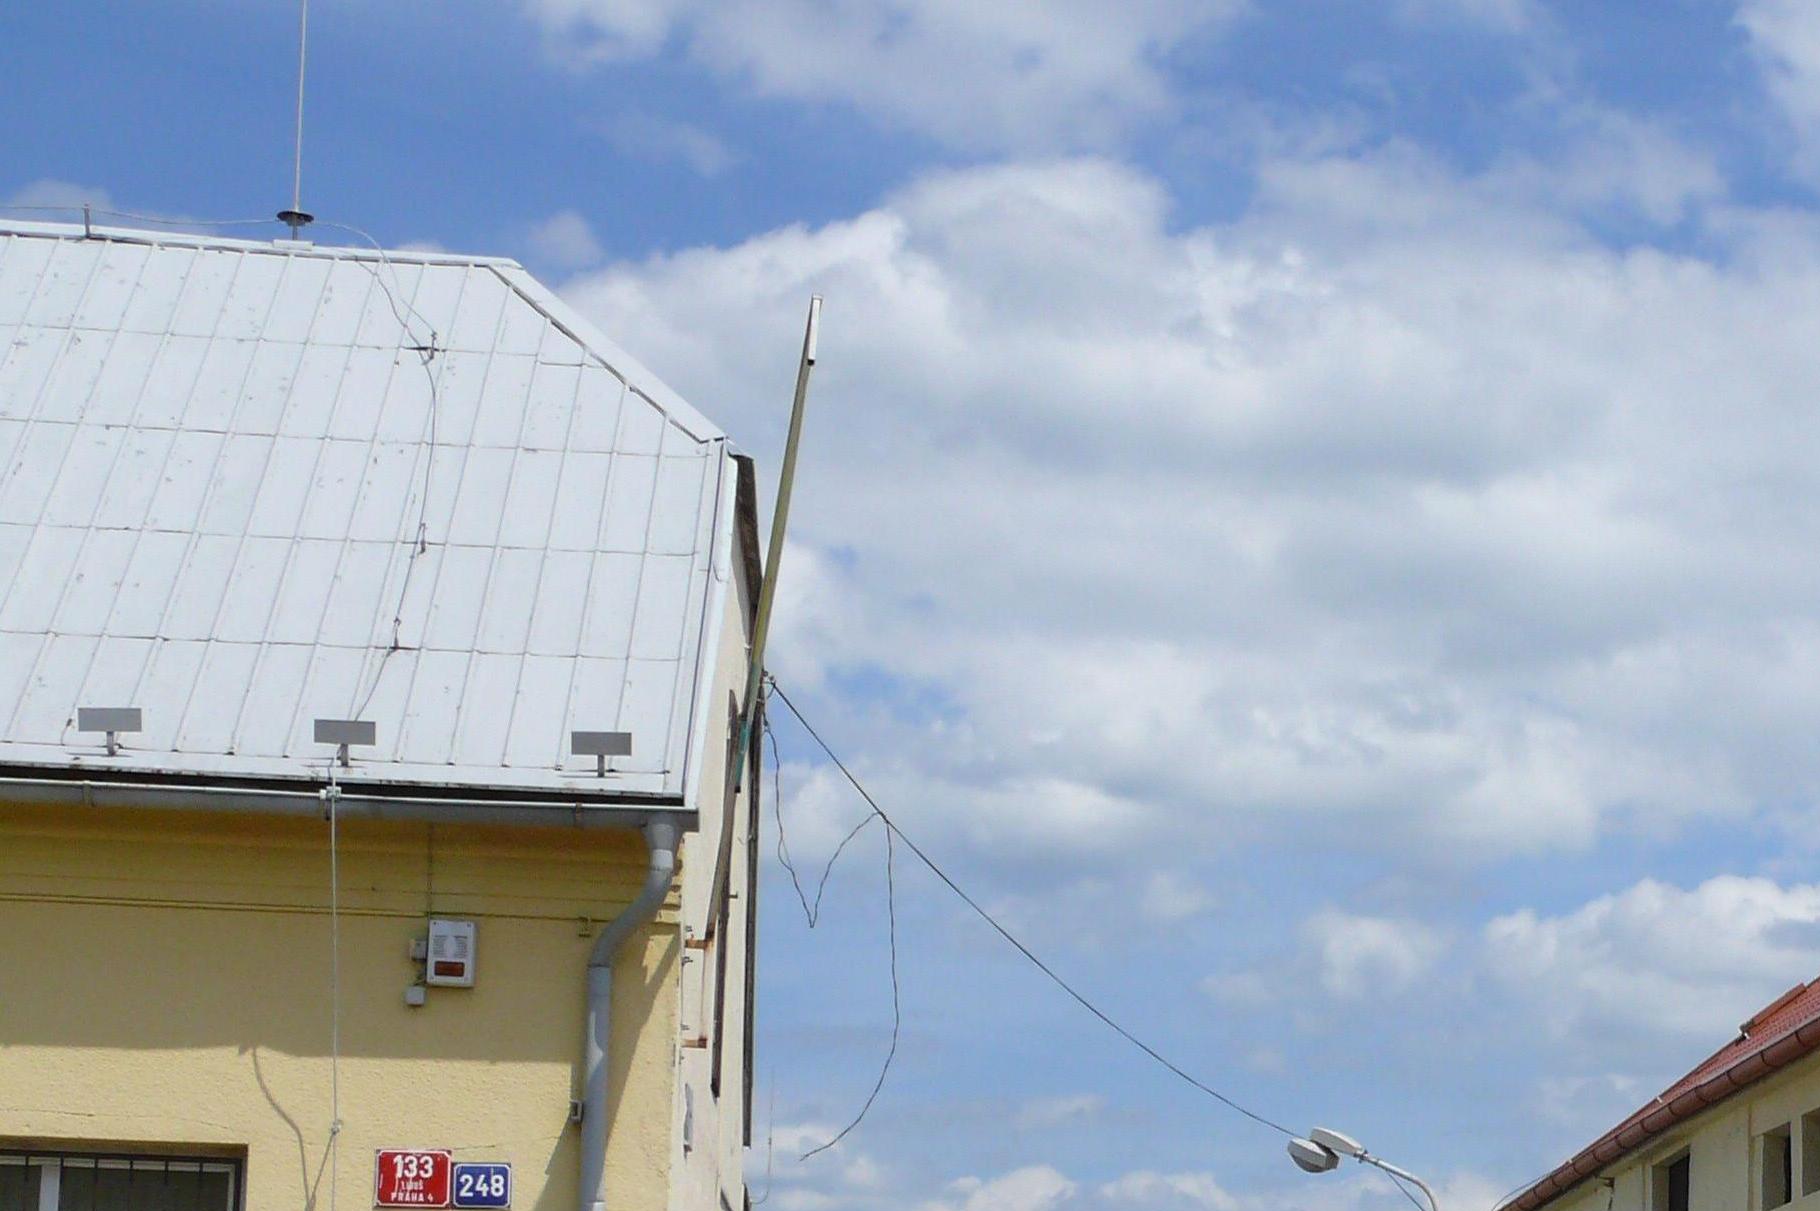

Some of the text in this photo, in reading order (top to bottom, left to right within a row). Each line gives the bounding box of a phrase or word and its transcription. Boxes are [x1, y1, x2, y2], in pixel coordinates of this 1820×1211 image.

[394, 1155, 433, 1178] 133
[391, 1192, 424, 1202] PRAHA
[459, 1174, 504, 1197] 248
